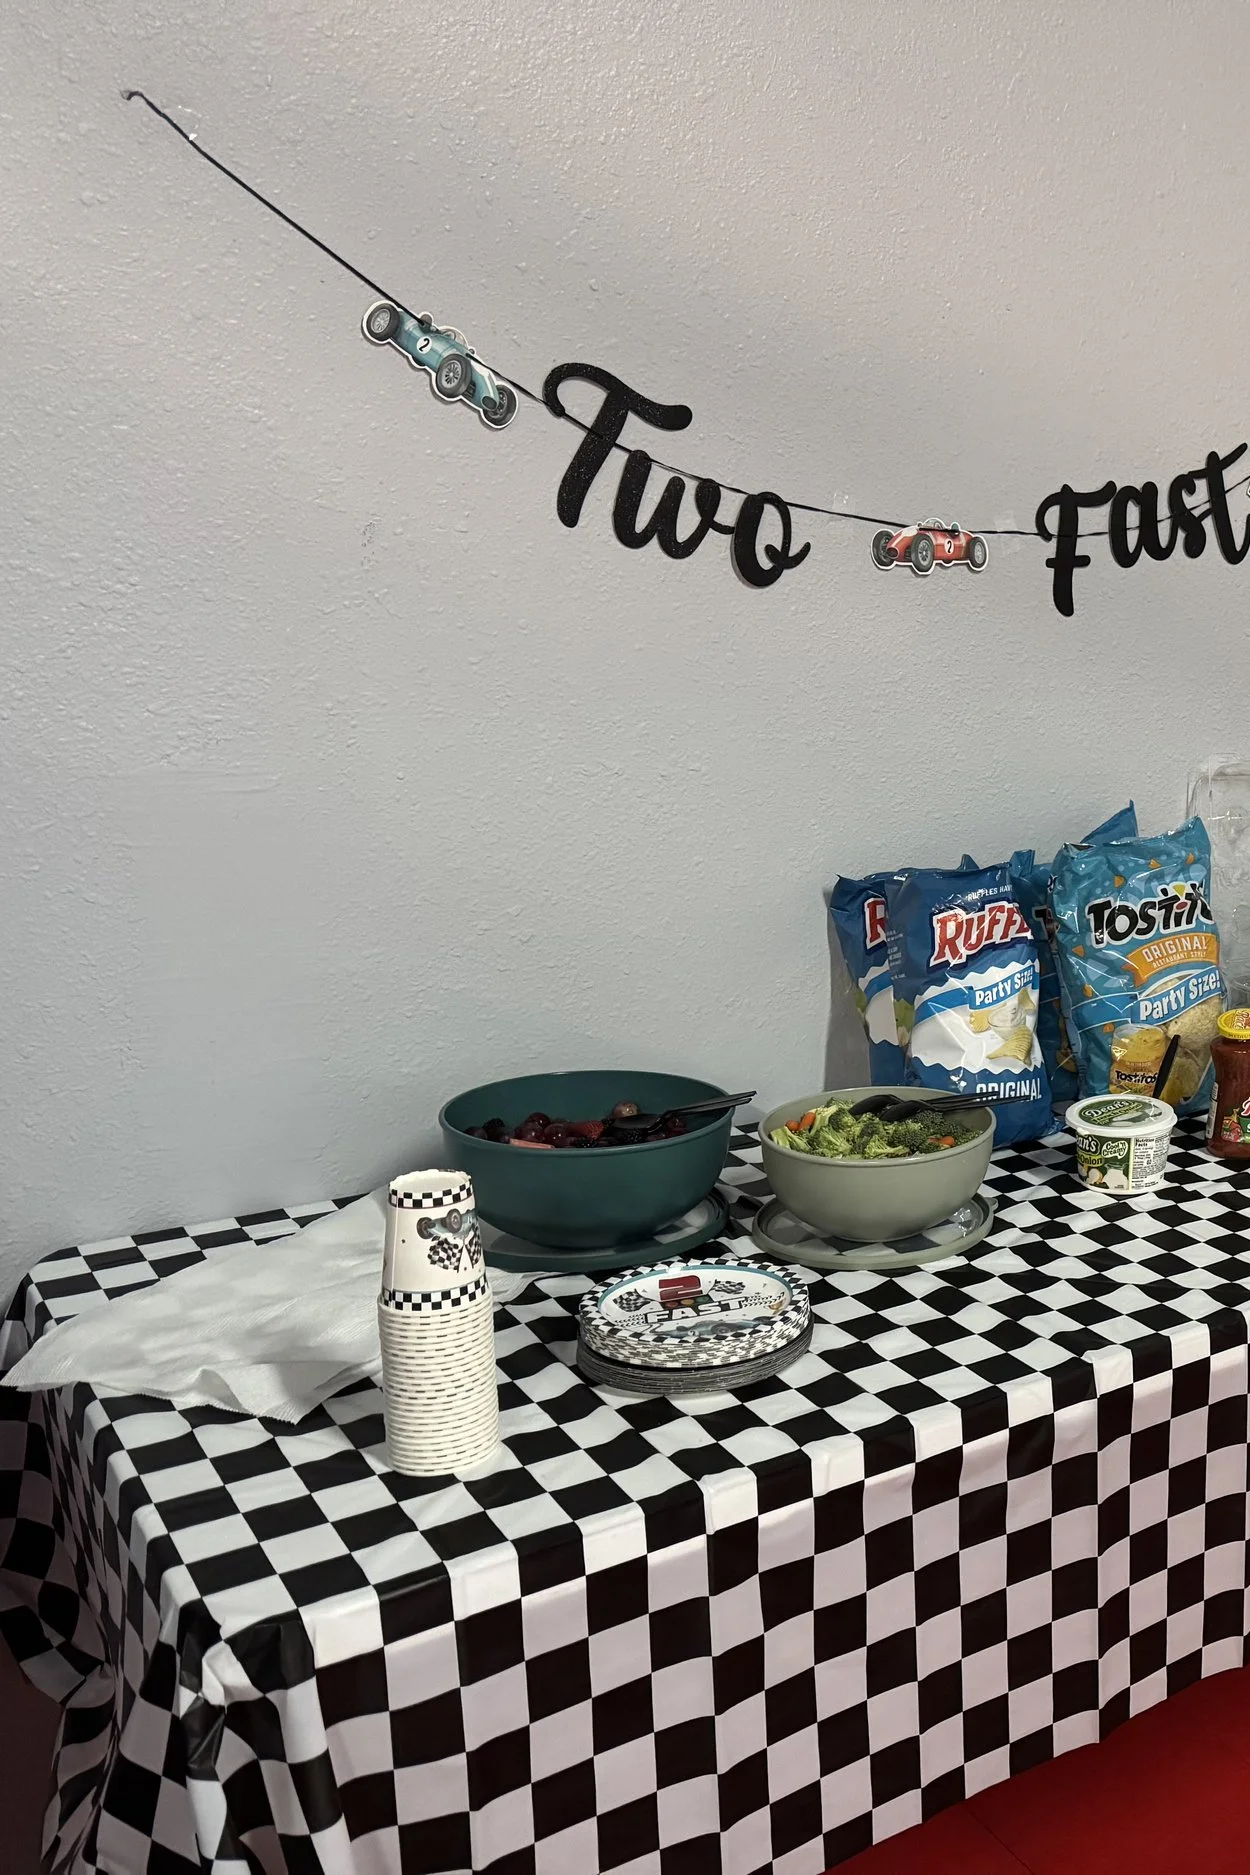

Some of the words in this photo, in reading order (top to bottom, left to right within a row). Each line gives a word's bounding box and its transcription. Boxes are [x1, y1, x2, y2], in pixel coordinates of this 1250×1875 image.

[419, 338, 430, 352] 2
[543, 362, 811, 588] Two
[947, 540, 952, 553] 2
[1143, 935, 1207, 962] ORIGINAL
[1152, 952, 1188, 968] RESTAURANT
[975, 979, 1012, 1006] Party
[1014, 968, 1033, 987] Size!
[1139, 988, 1186, 1021] Party
[1188, 970, 1221, 1000] Size!
[976, 1078, 1042, 1101] ORIGINAL
[1085, 1099, 1131, 1117] Dean's
[657, 1274, 703, 1303] 2
[646, 1297, 744, 1324] FAST
